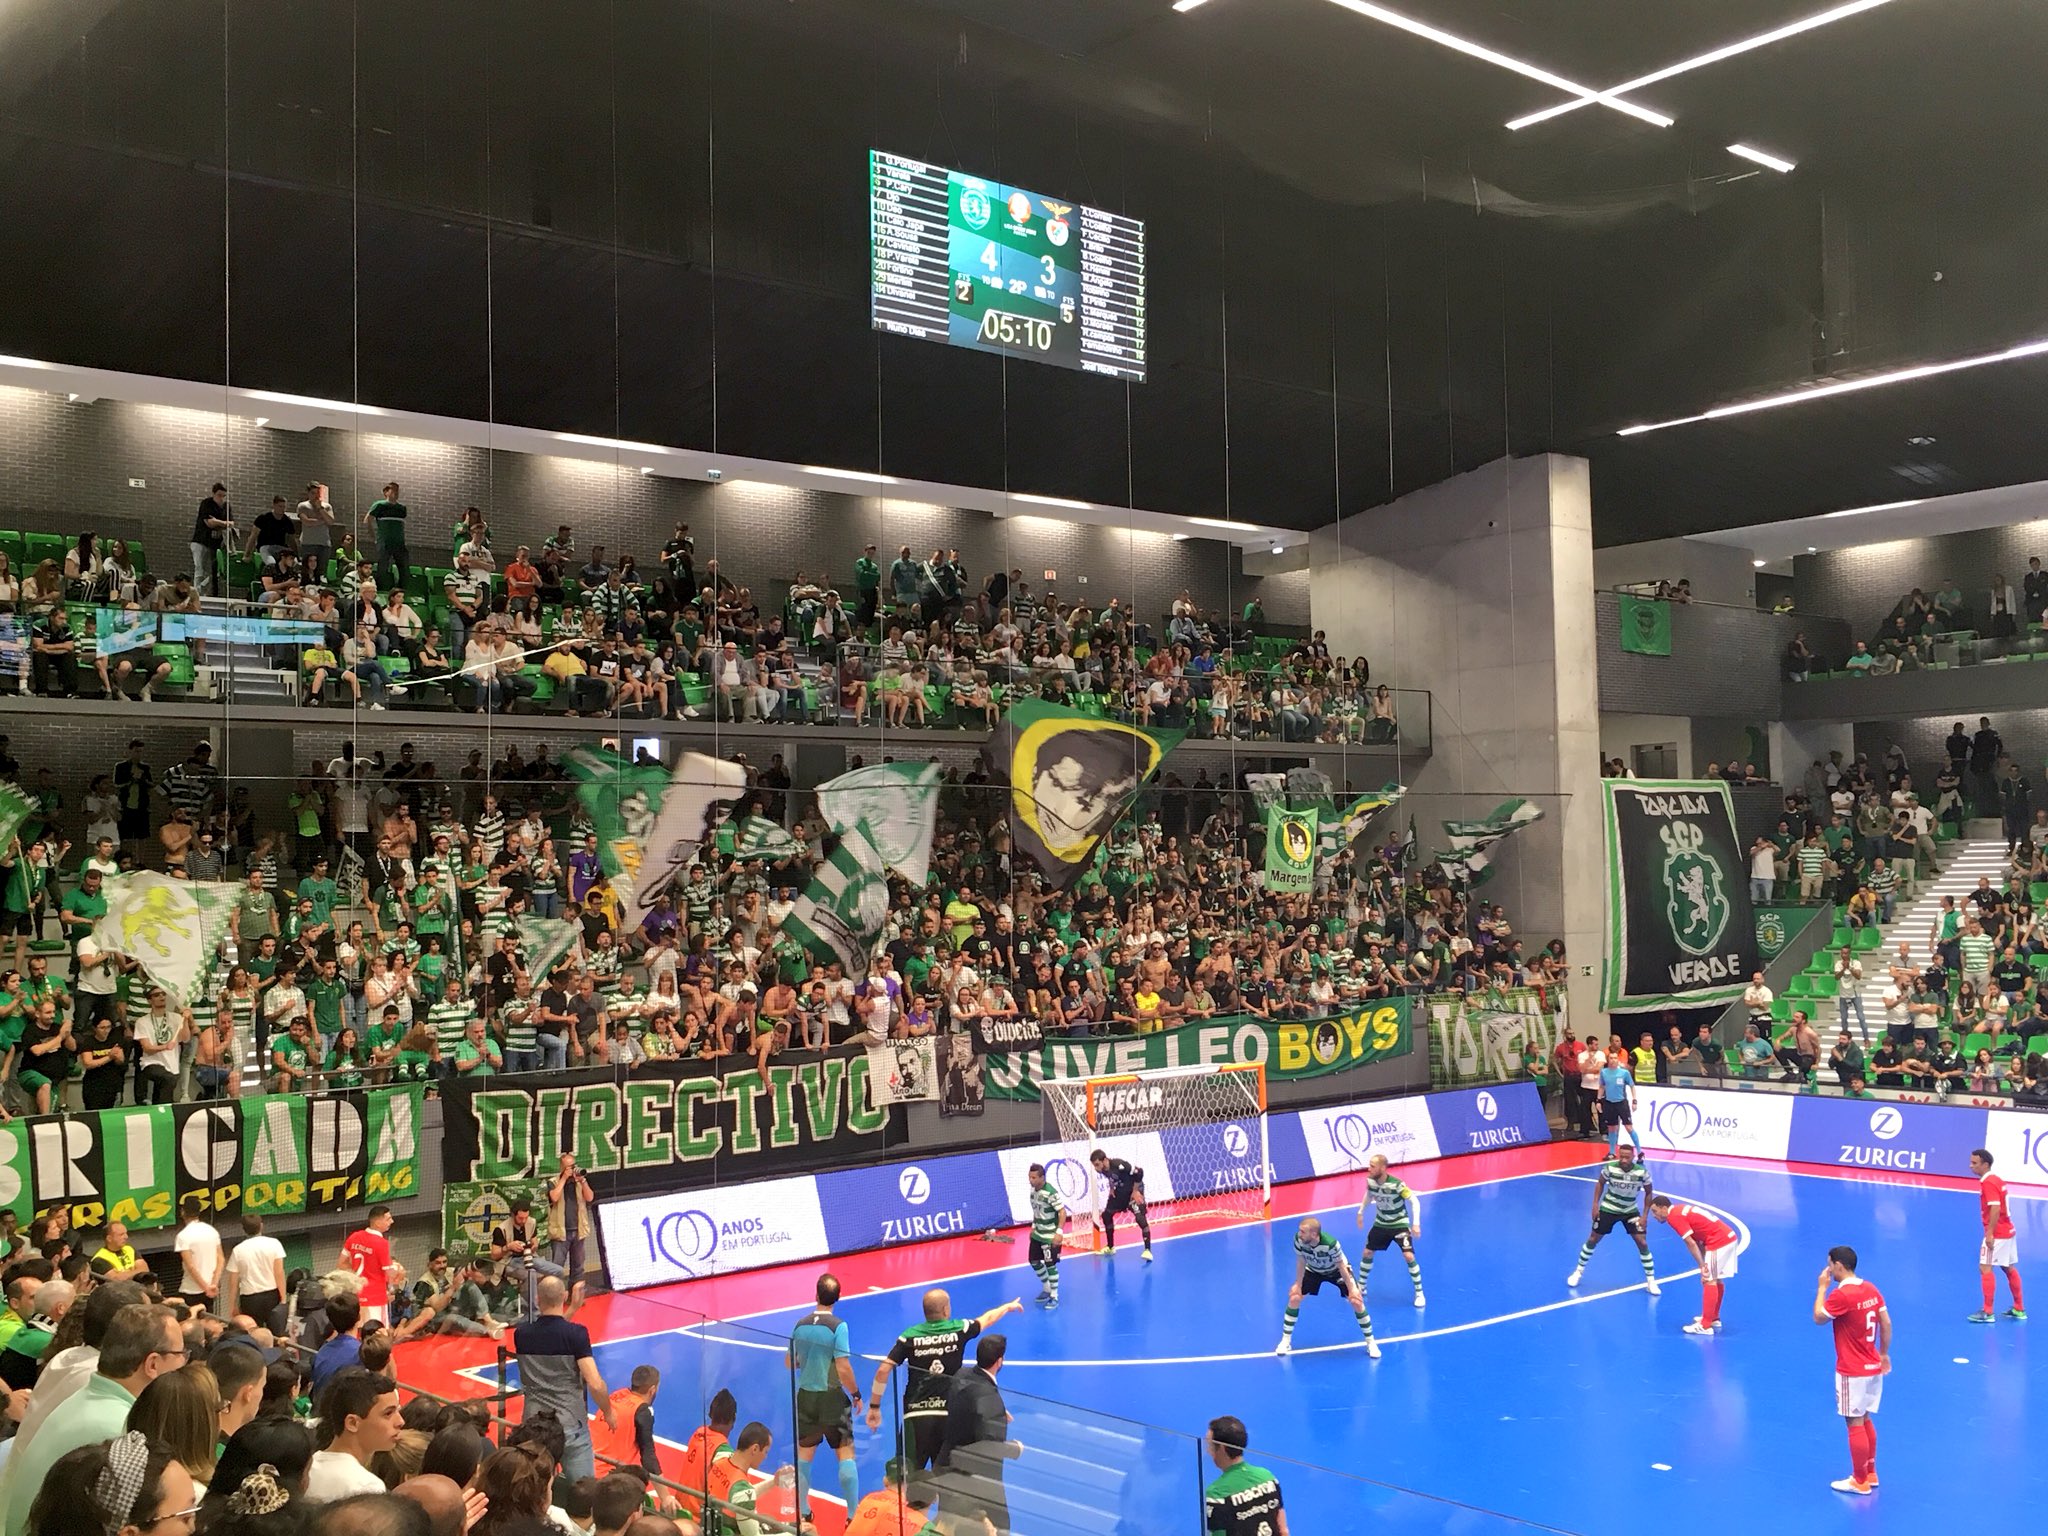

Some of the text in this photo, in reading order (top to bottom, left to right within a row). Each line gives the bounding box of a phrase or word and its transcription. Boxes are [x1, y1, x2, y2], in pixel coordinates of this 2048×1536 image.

[980, 241, 998, 272] 4
[1040, 255, 1056, 285] 3
[958, 284, 969, 301] 2
[1008, 279, 1028, 295] 2P
[1063, 296, 1074, 305] FTS
[1063, 307, 1073, 323] 5
[984, 311, 1052, 351] 05:10
[1634, 793, 1710, 819] TORCIDA
[1659, 820, 1704, 854] SCP
[1287, 858, 1309, 870] BOYS
[1270, 869, 1307, 886] Margem
[1759, 913, 1780, 922] SCP
[1668, 953, 1741, 986] VERDE
[1278, 1007, 1399, 1071] BOYS
[470, 1055, 891, 1182] DIRECTIVO
[1372, 1121, 1398, 1135] ANOS
[1704, 1116, 1738, 1128] ANOS
[1374, 1132, 1416, 1146] EM PORTUGAL
[1469, 1126, 1522, 1149] ZURICH
[0, 1093, 415, 1207] BRIGADA
[1839, 1145, 1926, 1170] ZURICH
[1212, 1162, 1277, 1190] ZURICH
[721, 1217, 763, 1236] ANOS
[881, 1209, 965, 1242] ZURICH
[722, 1232, 792, 1251] EM PORTUGAL
[1403, 1237, 1409, 1247] 6
[1866, 1310, 1876, 1342] 5
[913, 1332, 959, 1346] macron
[914, 1347, 944, 1357] Sporting
[1231, 1480, 1277, 1507] macron
